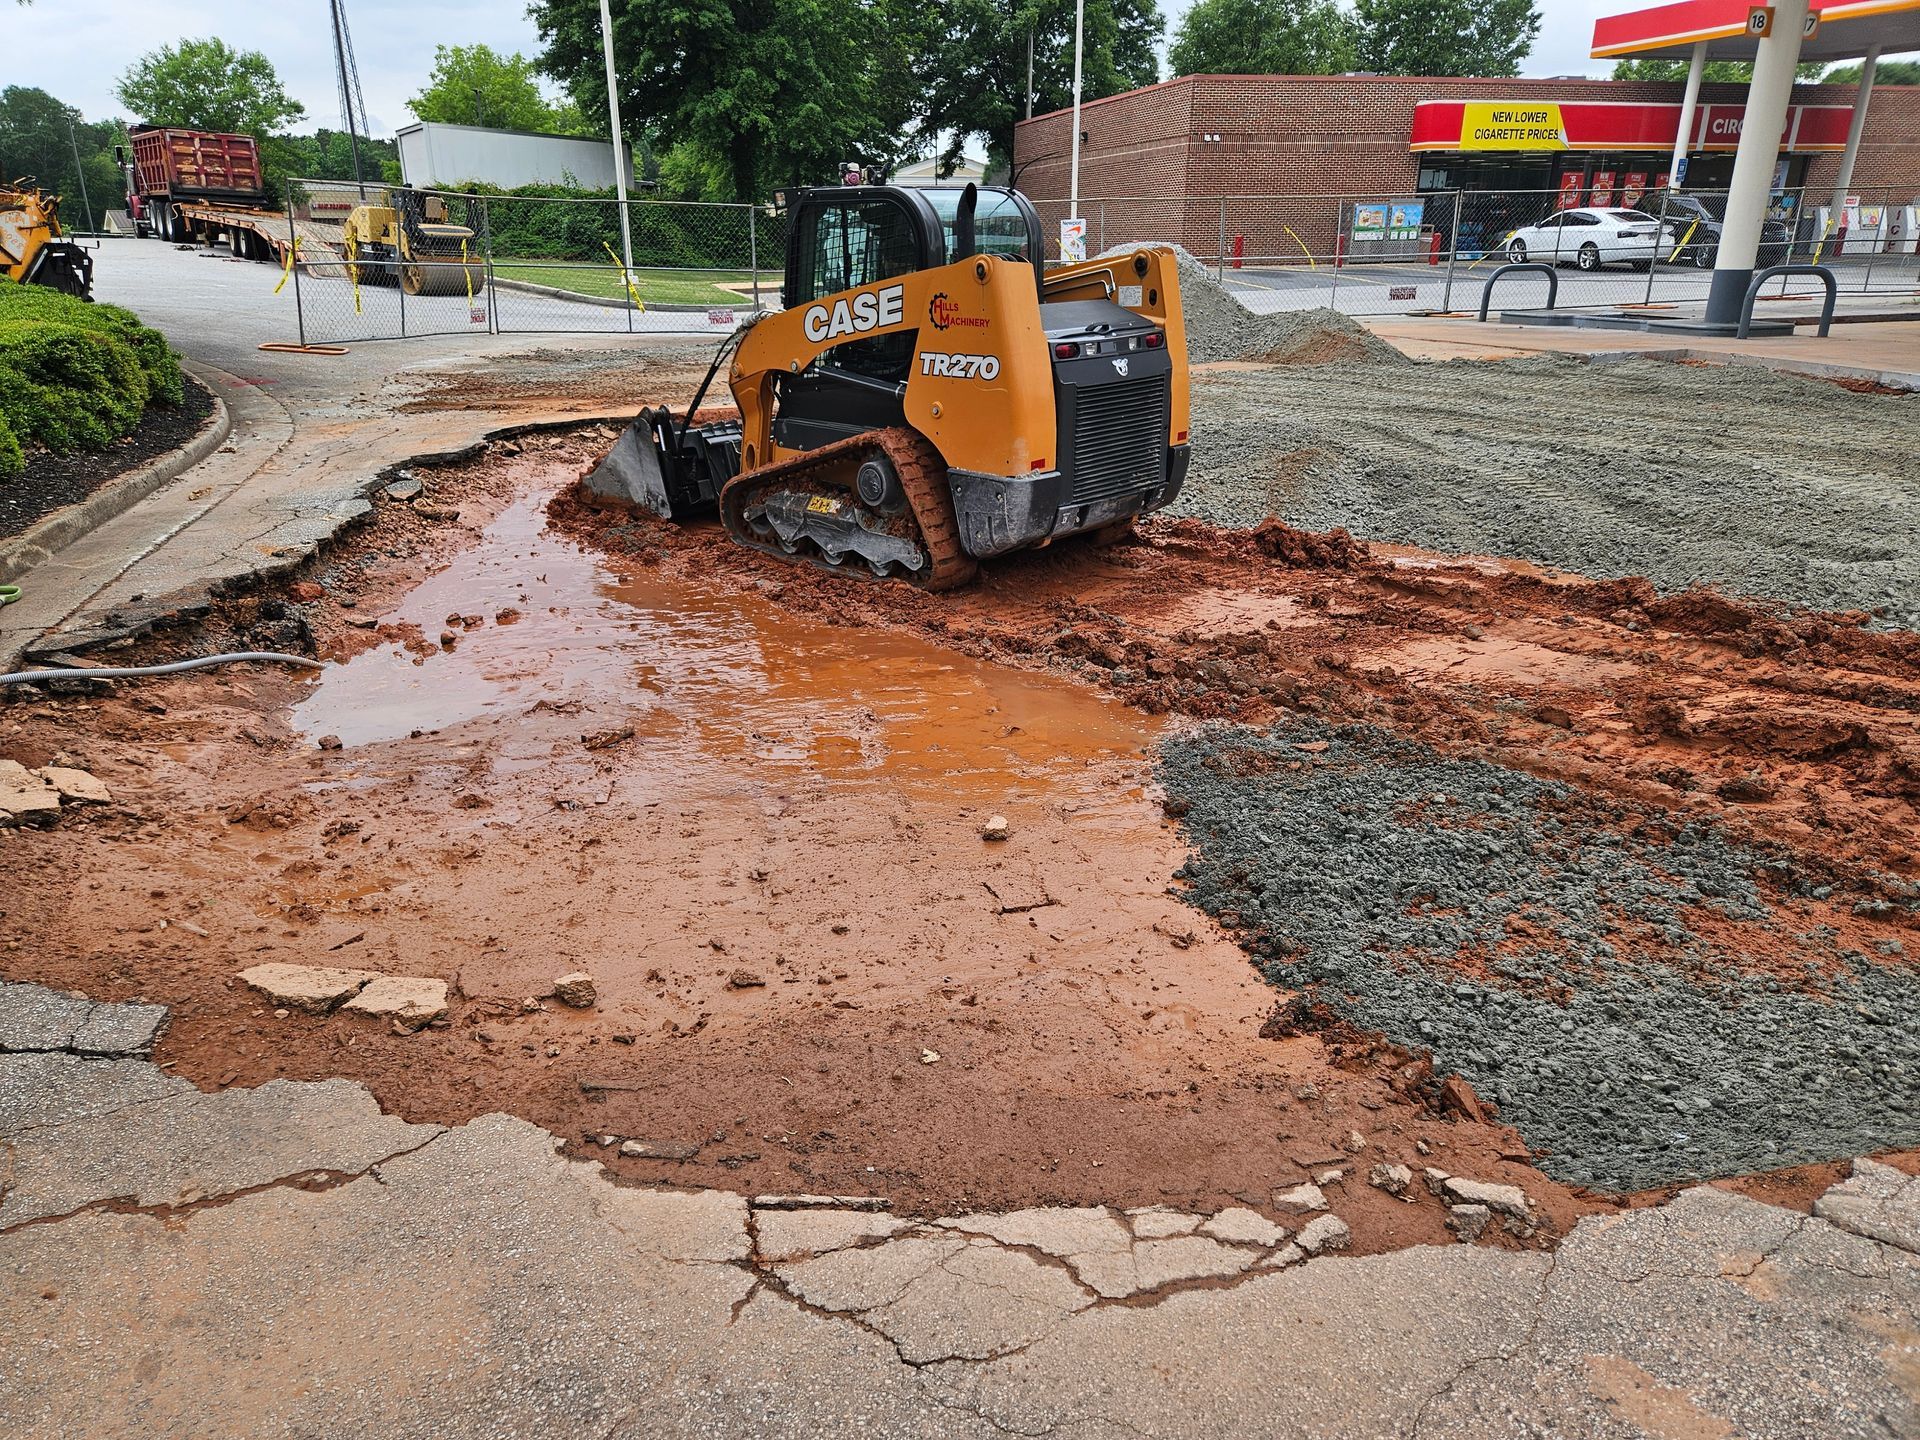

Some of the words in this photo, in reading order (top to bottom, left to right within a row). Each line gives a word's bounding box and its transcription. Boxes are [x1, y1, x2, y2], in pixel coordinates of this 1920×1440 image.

[1752, 15, 1765, 28] 18
[1491, 112, 1513, 122] NEW
[1515, 112, 1548, 123] LOWER
[1474, 129, 1526, 140] CIGARETTE
[1527, 129, 1559, 139] PRICES
[803, 283, 904, 343] CASE
[939, 310, 991, 328] MACHINERY
[919, 351, 1001, 381] TR270
